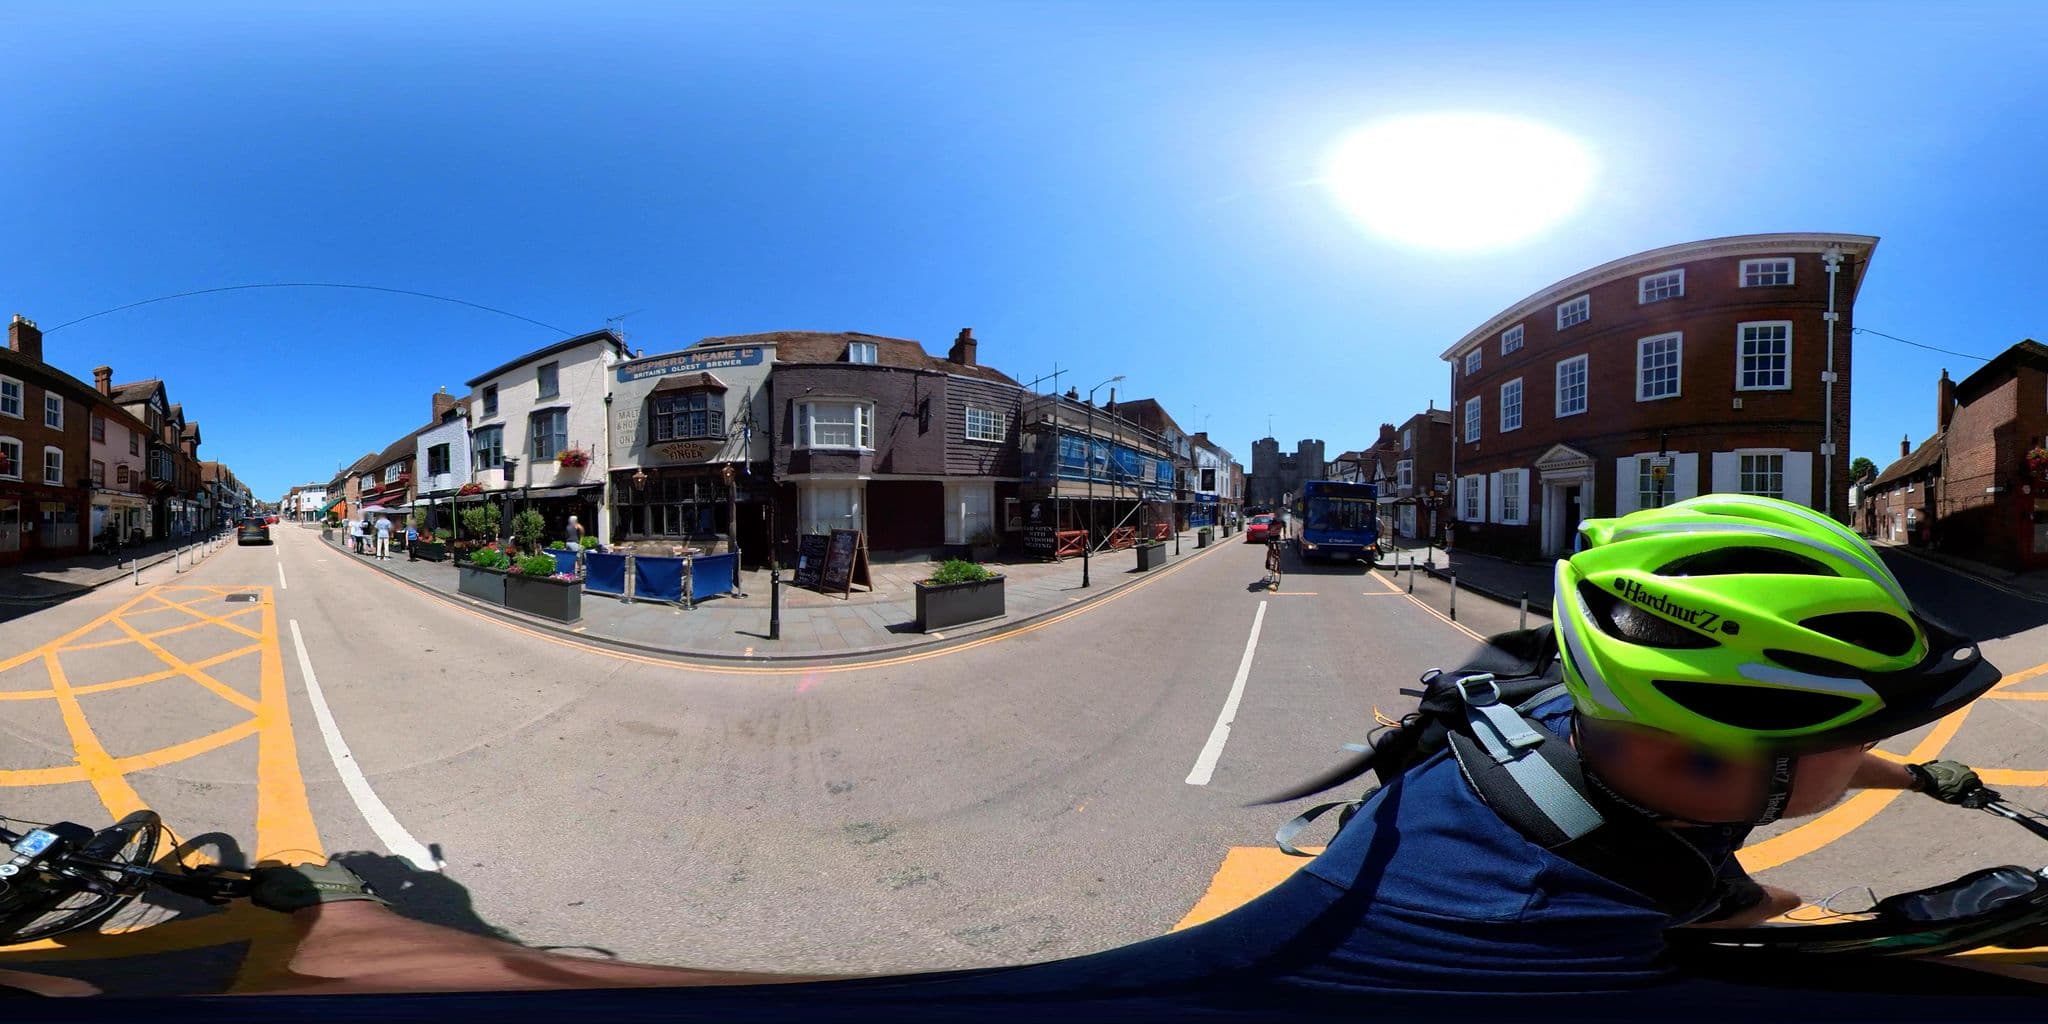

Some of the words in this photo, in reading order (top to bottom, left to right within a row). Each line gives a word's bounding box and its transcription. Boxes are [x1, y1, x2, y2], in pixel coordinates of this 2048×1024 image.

[624, 356, 686, 373] SHEPHERD
[692, 349, 736, 363] NEAME
[671, 363, 700, 373] OLDEST
[706, 359, 742, 368] BREWER
[669, 449, 703, 460] FINGER
[1623, 578, 1720, 634] HardnutZ
